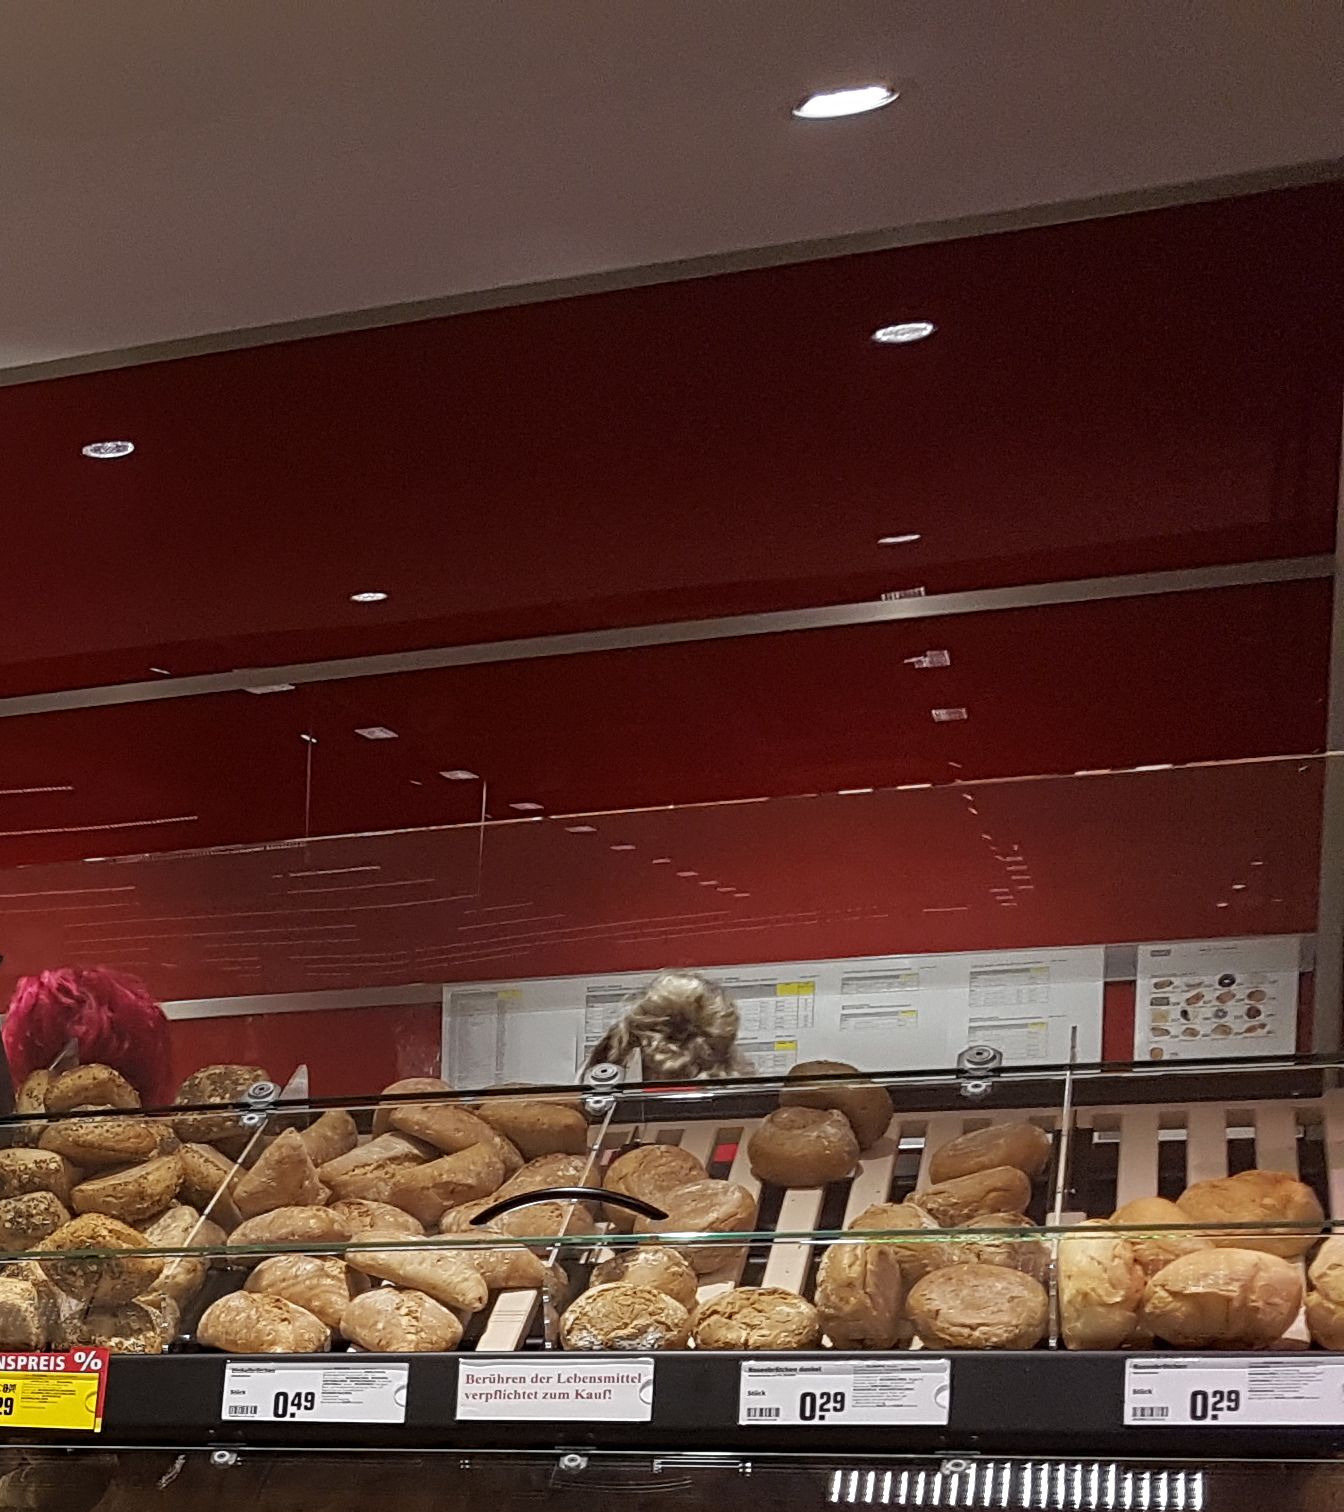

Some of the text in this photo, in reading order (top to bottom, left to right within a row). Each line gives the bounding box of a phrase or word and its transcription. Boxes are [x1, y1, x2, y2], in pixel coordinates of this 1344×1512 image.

[465, 1373, 642, 1386] Berühren der Lebensmittel
[273, 1391, 316, 1418] 0.49
[464, 1388, 612, 1403] verpflichtet zum Kauf!
[799, 1391, 846, 1421] 0.29
[1189, 1389, 1241, 1421] 0.29
